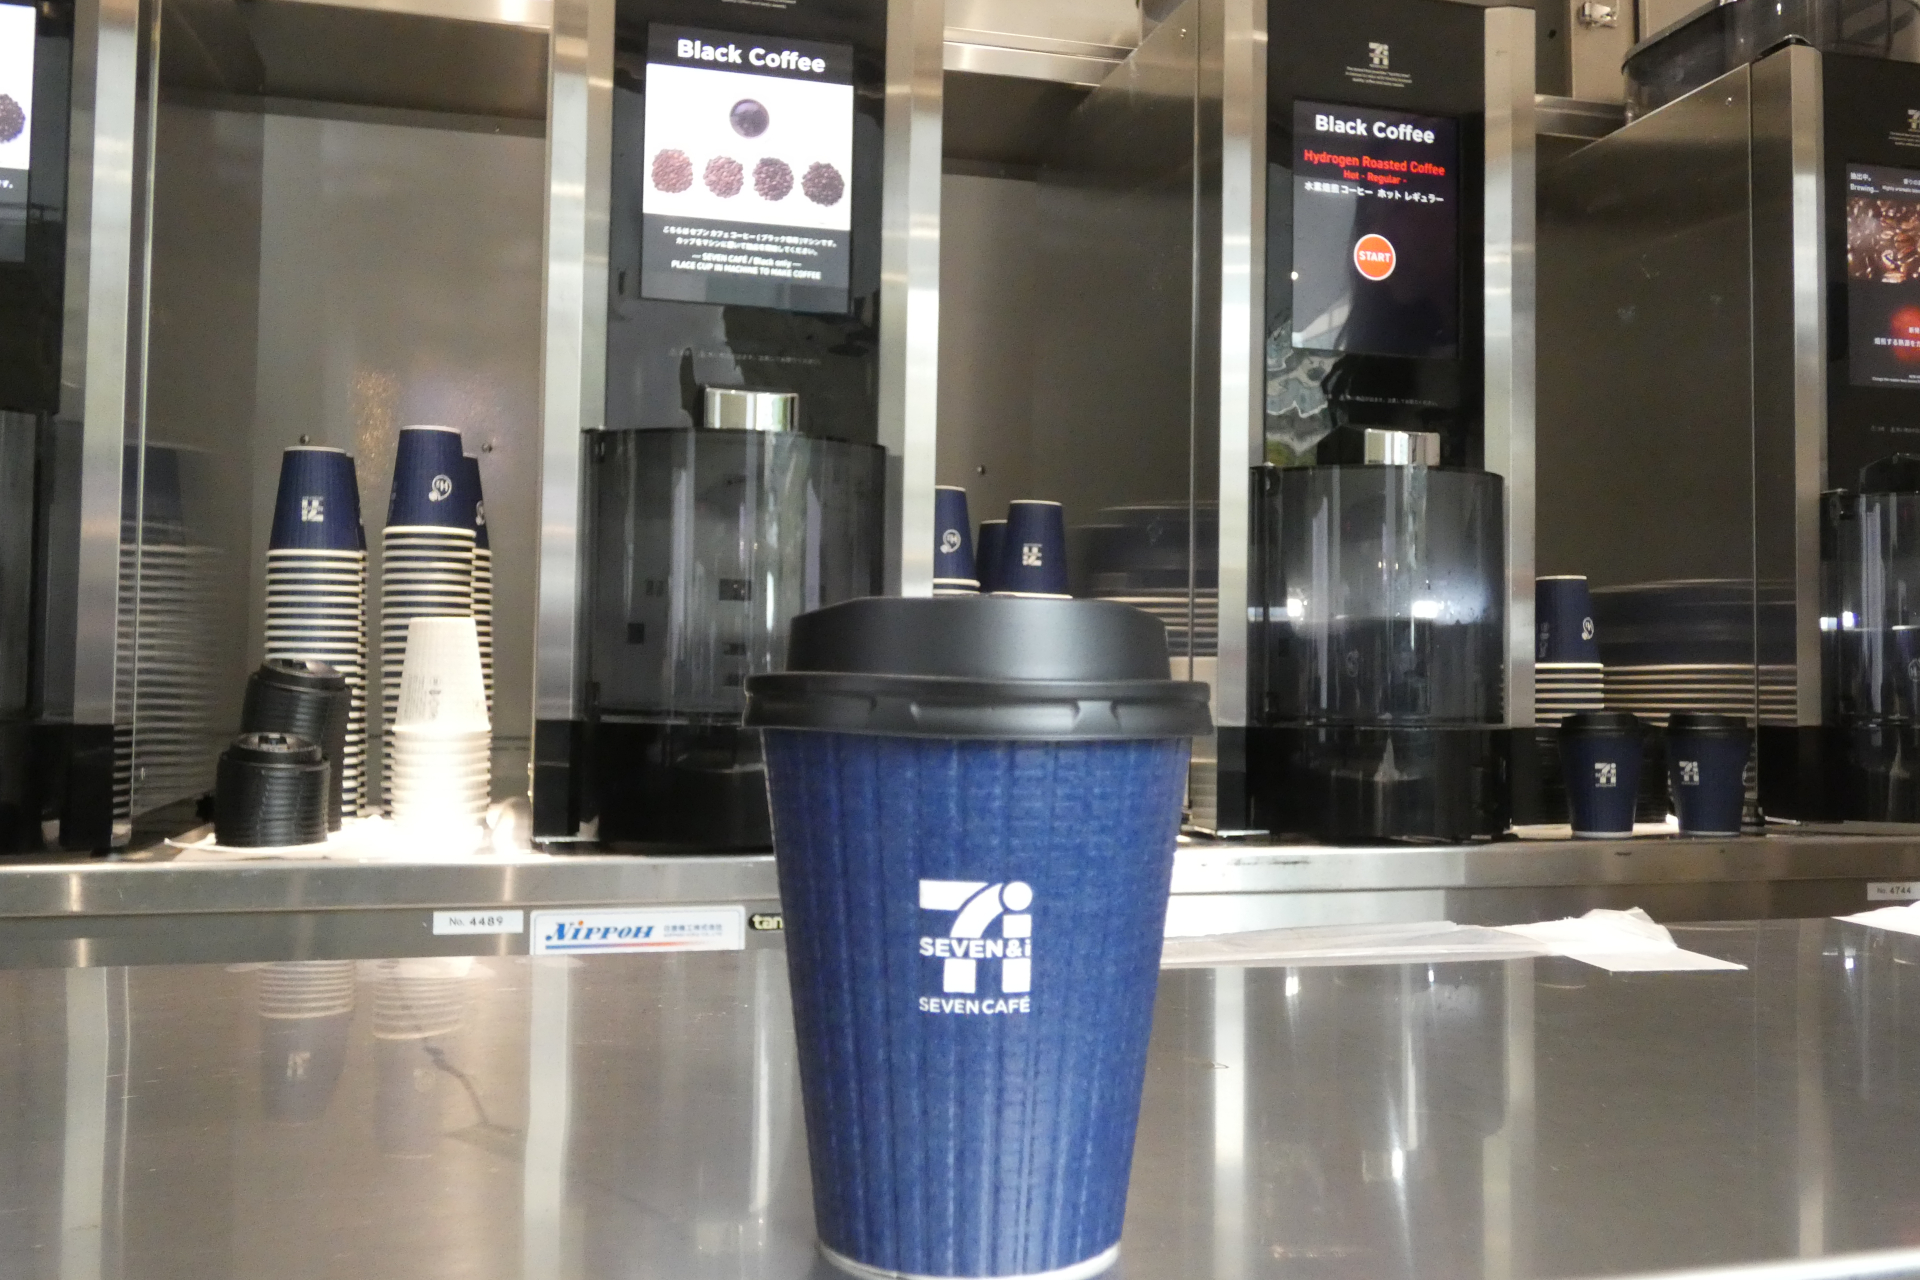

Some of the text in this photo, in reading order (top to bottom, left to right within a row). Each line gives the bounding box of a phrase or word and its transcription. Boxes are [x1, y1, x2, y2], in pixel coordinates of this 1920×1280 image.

[677, 39, 826, 73] Black Coffee
[1315, 114, 1435, 144] Black Coffee
[1304, 149, 1446, 176] Hydrogen Roasted Coffee
[1343, 169, 1360, 180] Hot
[1367, 171, 1401, 185] Regular
[1304, 180, 1444, 203] 水コーヒー ホット レギュラー
[702, 252, 728, 263] SEVEN
[753, 256, 774, 267] Black
[774, 259, 793, 269] only
[1358, 250, 1391, 263] START
[671, 259, 822, 280] PLACE CUP IN MACHINE TO MAKE COFFEE
[1889, 886, 1911, 894] 4744
[448, 915, 503, 926] No. 4489
[919, 995, 1031, 1015] SEVEN CAFÉ
